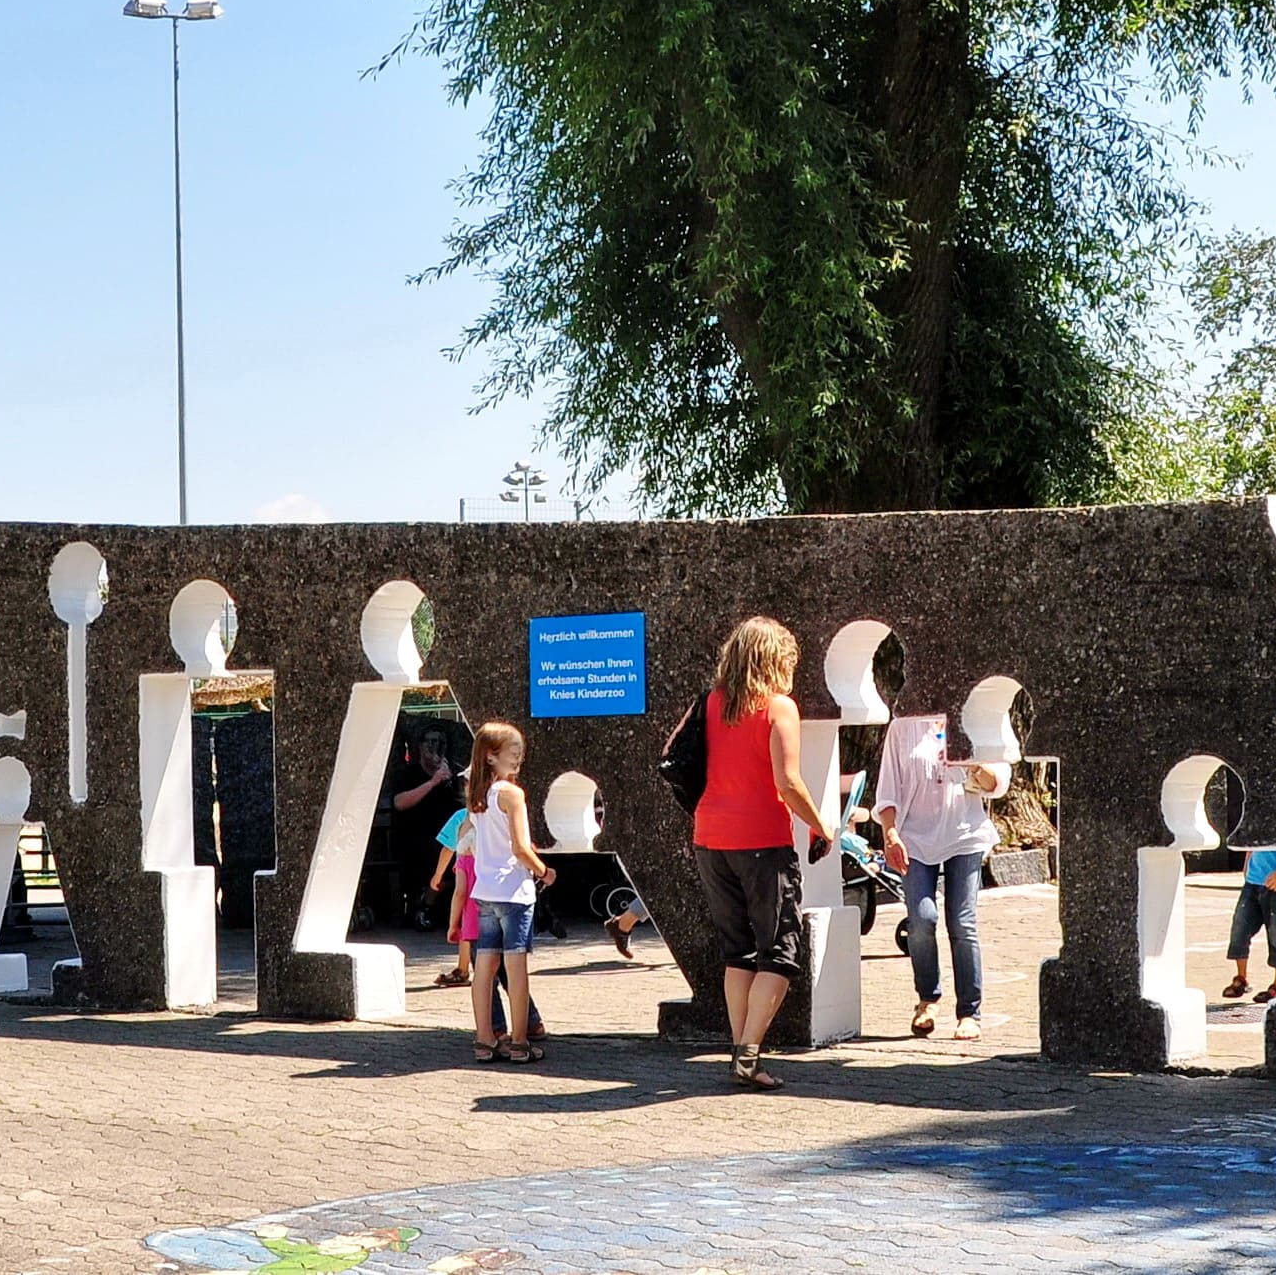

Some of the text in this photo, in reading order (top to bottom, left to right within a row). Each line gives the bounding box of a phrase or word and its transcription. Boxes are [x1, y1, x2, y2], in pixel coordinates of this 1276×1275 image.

[539, 628, 634, 644] Herzlich willkommen
[541, 658, 633, 671] Wir wünschen Ihnen
[537, 672, 637, 686] erholsame Stunden in
[549, 687, 625, 700] Knies Kinderzoo
